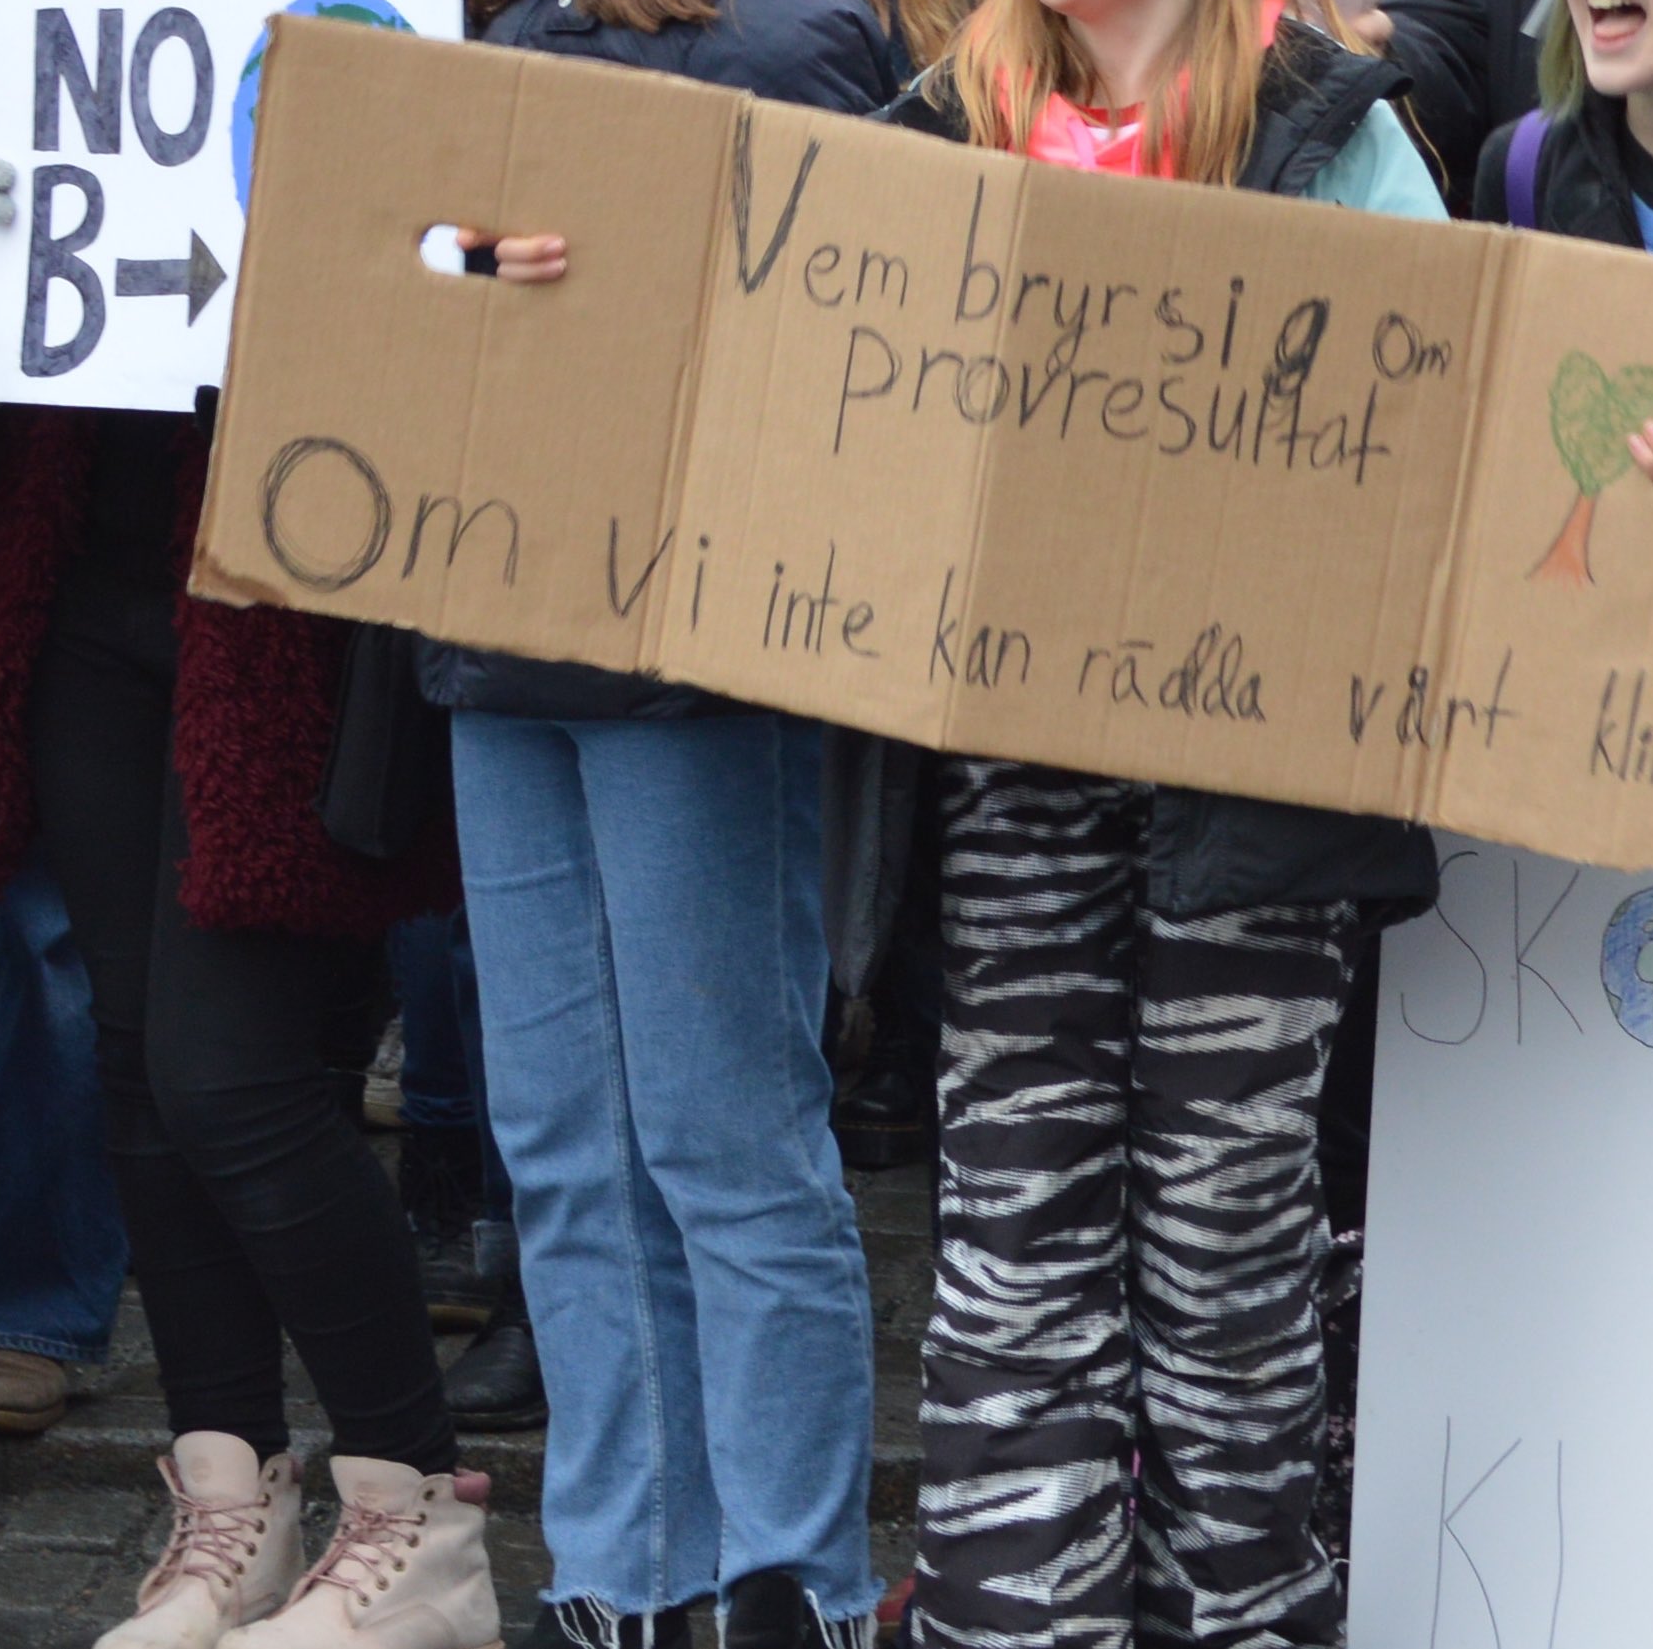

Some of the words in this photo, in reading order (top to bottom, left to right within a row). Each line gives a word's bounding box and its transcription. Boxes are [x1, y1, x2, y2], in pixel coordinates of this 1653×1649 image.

[31, 5, 215, 167] NO
[19, 164, 106, 378] B
[732, 110, 909, 309] Vem
[954, 172, 1139, 372] bryr
[258, 435, 520, 593] Om
[763, 540, 881, 659] inte
[929, 565, 1032, 690] kan
